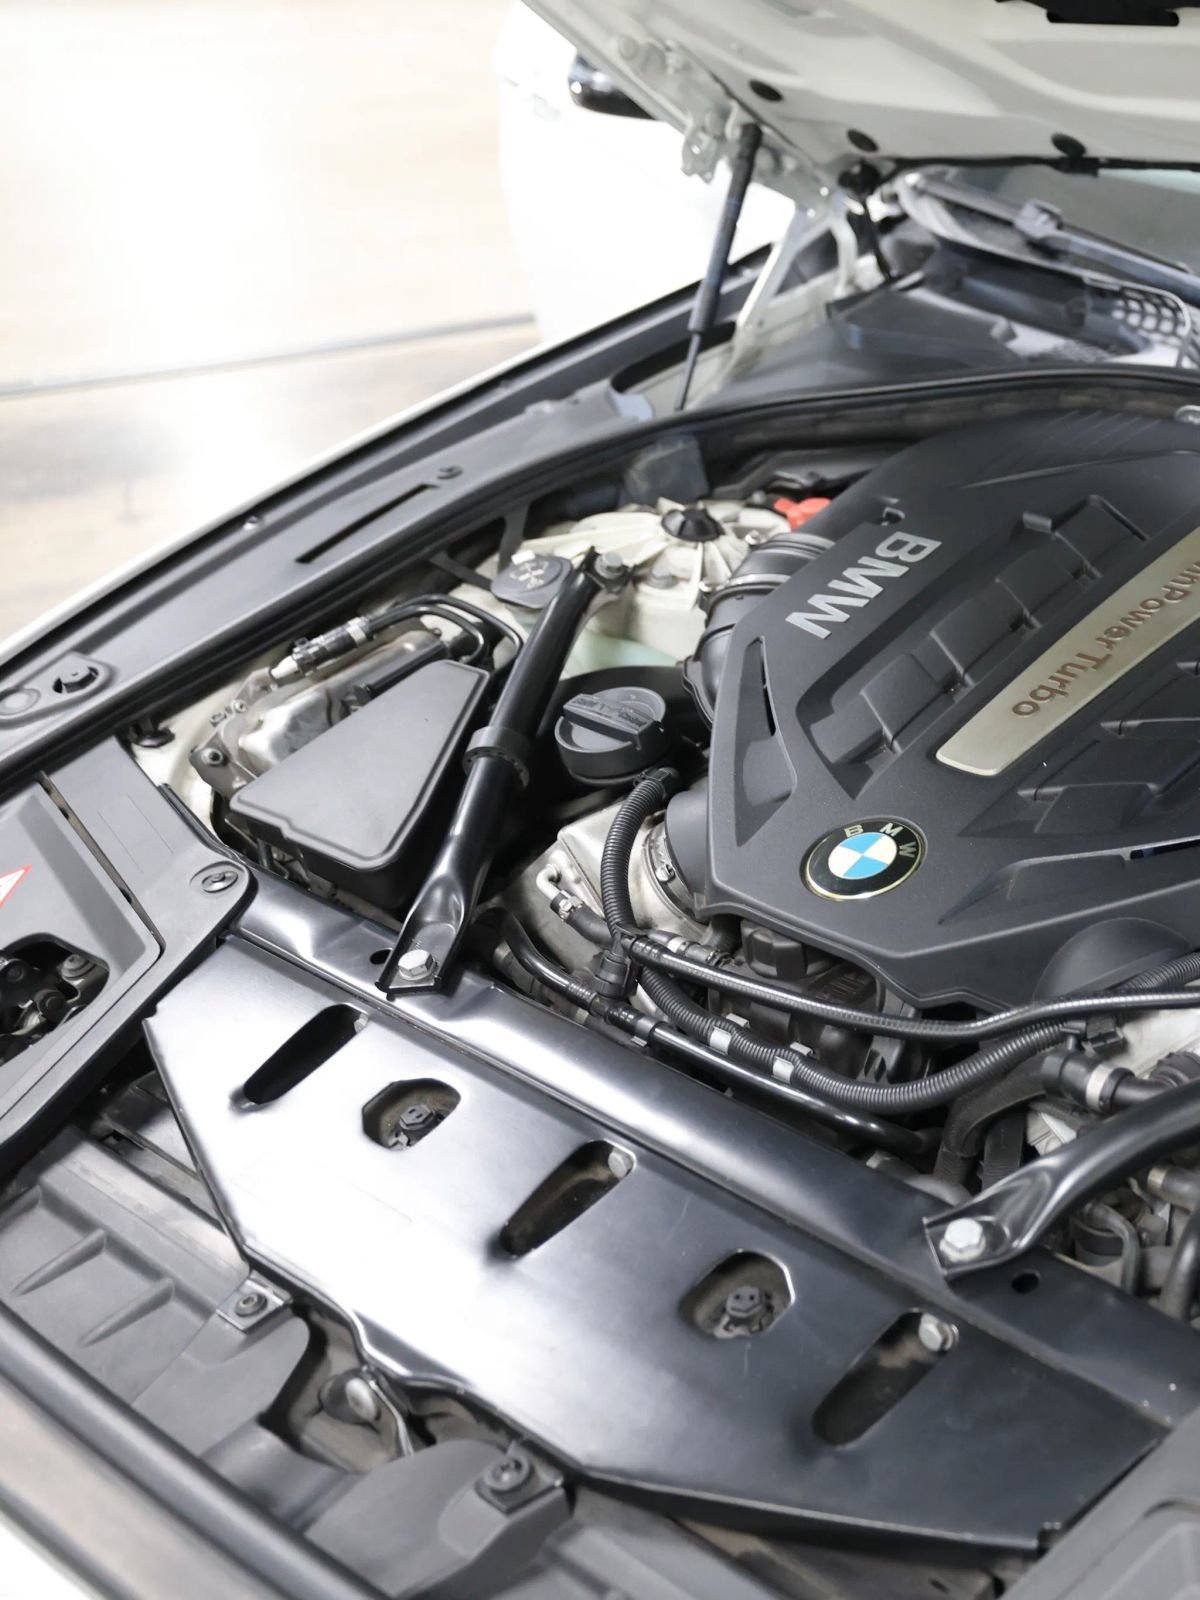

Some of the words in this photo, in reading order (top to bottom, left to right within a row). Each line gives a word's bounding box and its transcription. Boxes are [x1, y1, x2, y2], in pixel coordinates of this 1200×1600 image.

[785, 531, 942, 640] BMW
[1012, 652, 1112, 717] Turbo
[844, 822, 917, 858] BMW
